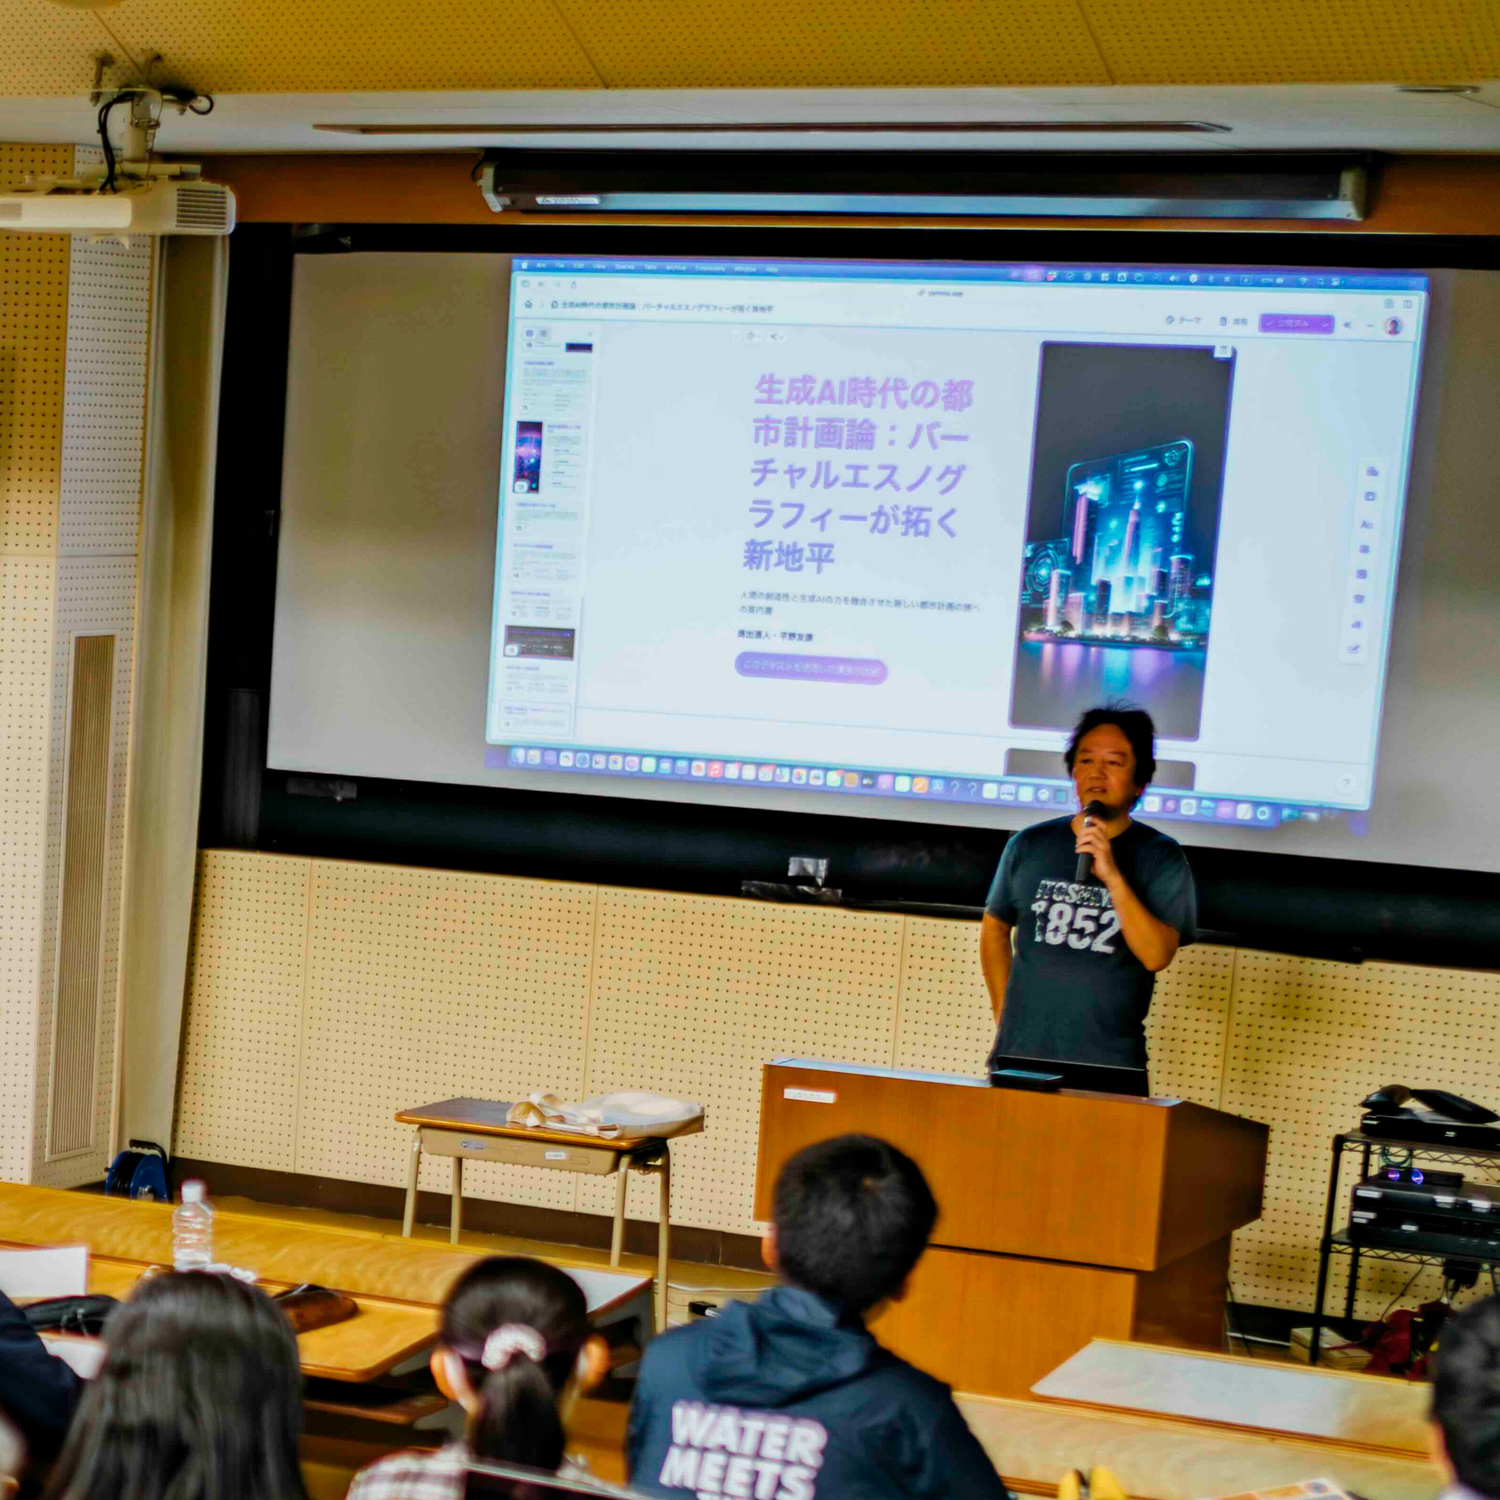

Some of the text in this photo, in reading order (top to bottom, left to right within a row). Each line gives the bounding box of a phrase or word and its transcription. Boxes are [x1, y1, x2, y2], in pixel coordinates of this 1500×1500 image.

[754, 373, 975, 412] 生成AI時代の都
[752, 414, 970, 451] 市計画論：バー
[750, 457, 968, 496] チャルエスノグ
[749, 499, 957, 539] ラフィーが拓く
[742, 539, 835, 575] 新地平
[1031, 901, 1121, 954] 1852
[671, 1401, 829, 1469] WATER
